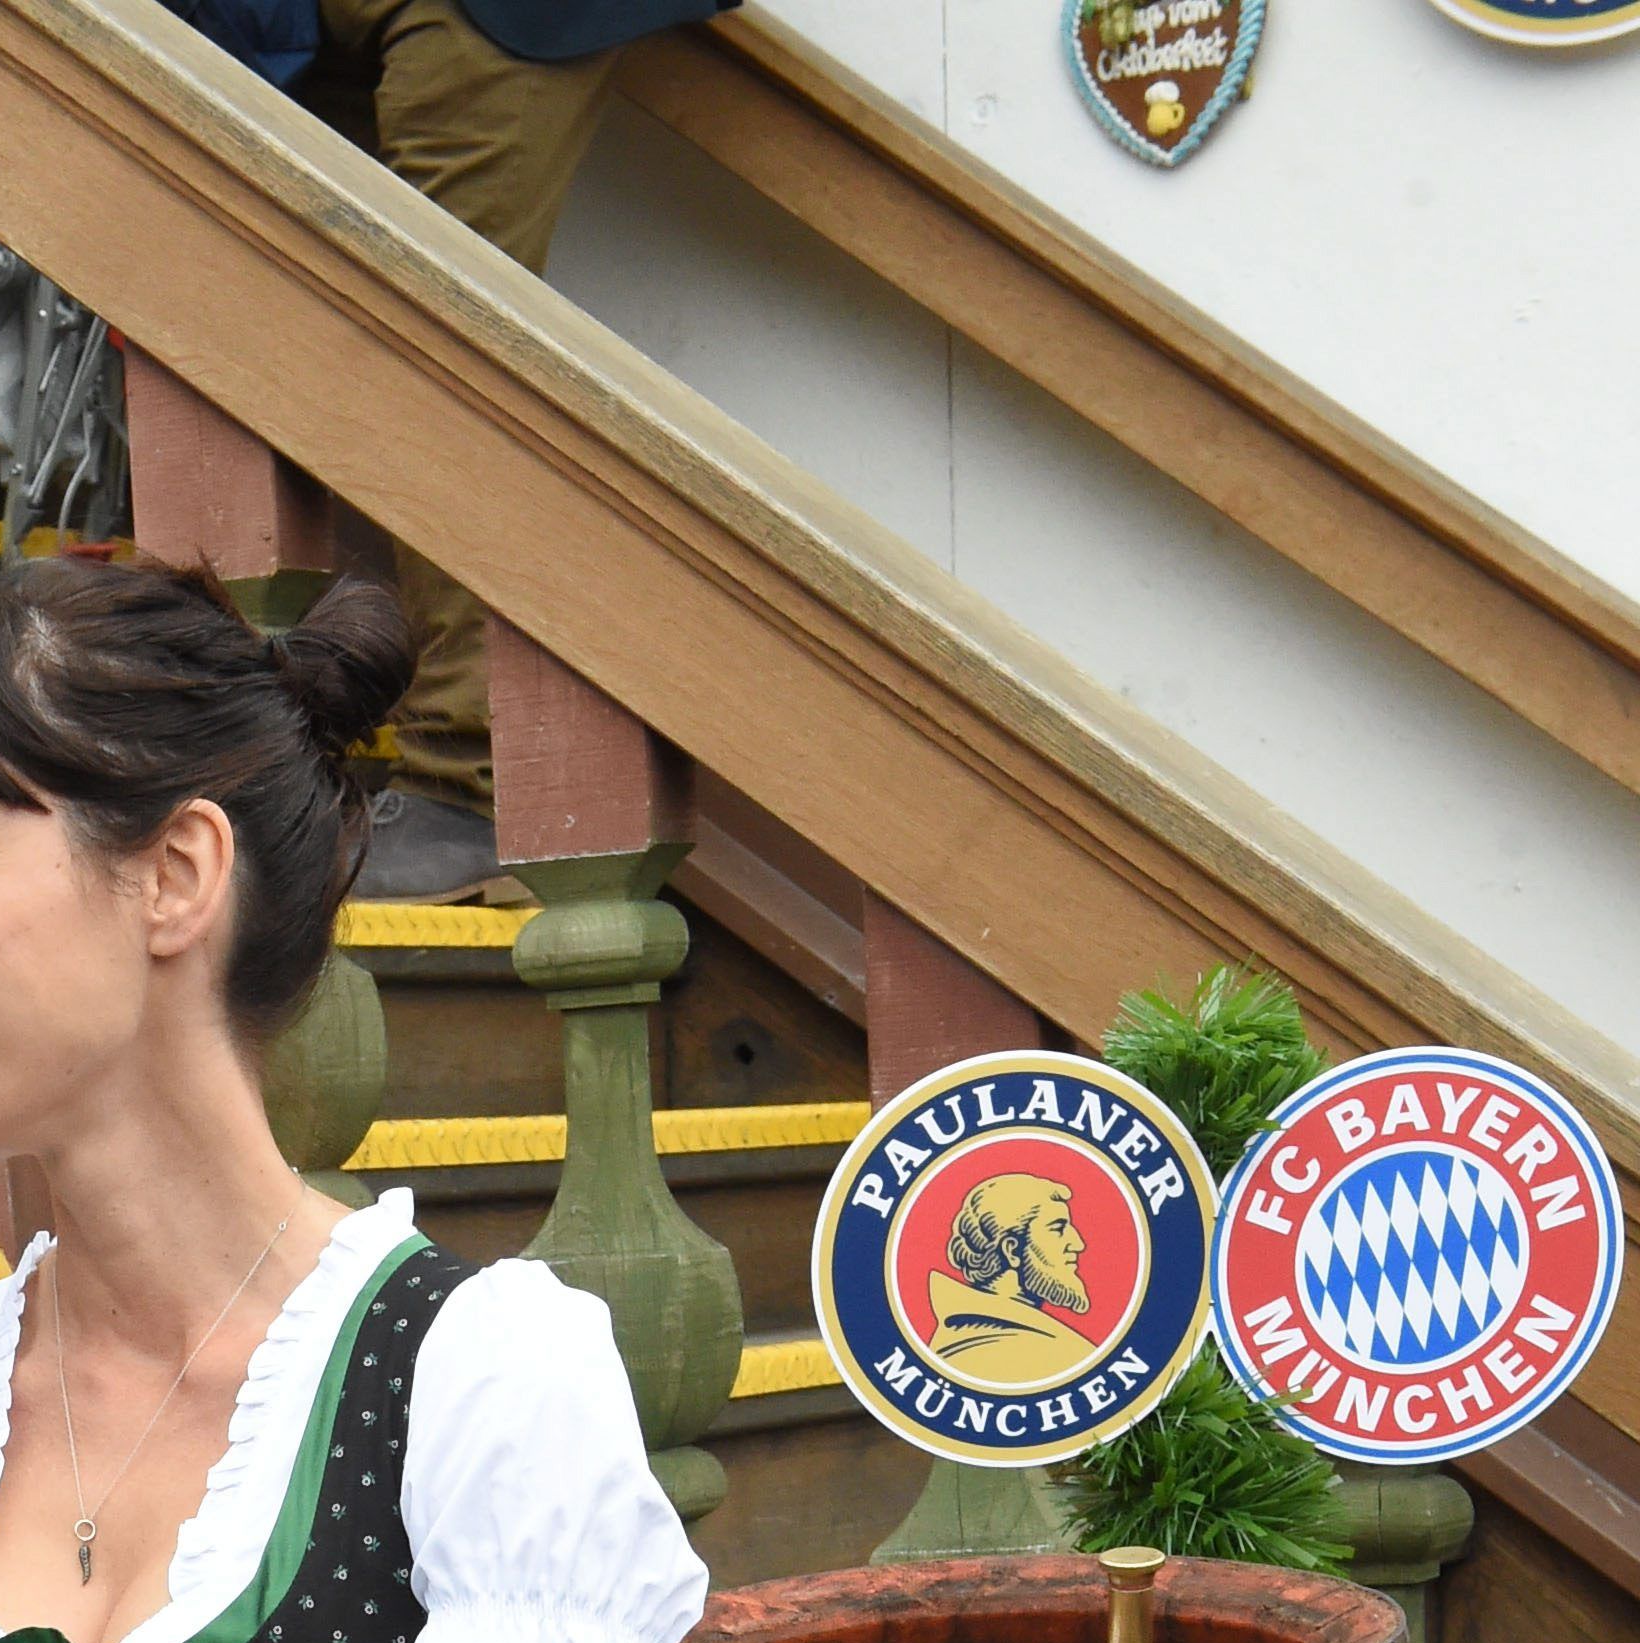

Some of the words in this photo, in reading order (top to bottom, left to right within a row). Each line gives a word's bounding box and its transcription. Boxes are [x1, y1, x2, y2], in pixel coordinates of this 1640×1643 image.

[851, 1078, 1186, 1219] PAULANER
[1244, 1144, 1321, 1236] FC
[1324, 1082, 1586, 1232] BAYERN
[873, 1345, 1150, 1438] MÜNCHEN
[1243, 1293, 1576, 1434] MÜNCHEN
